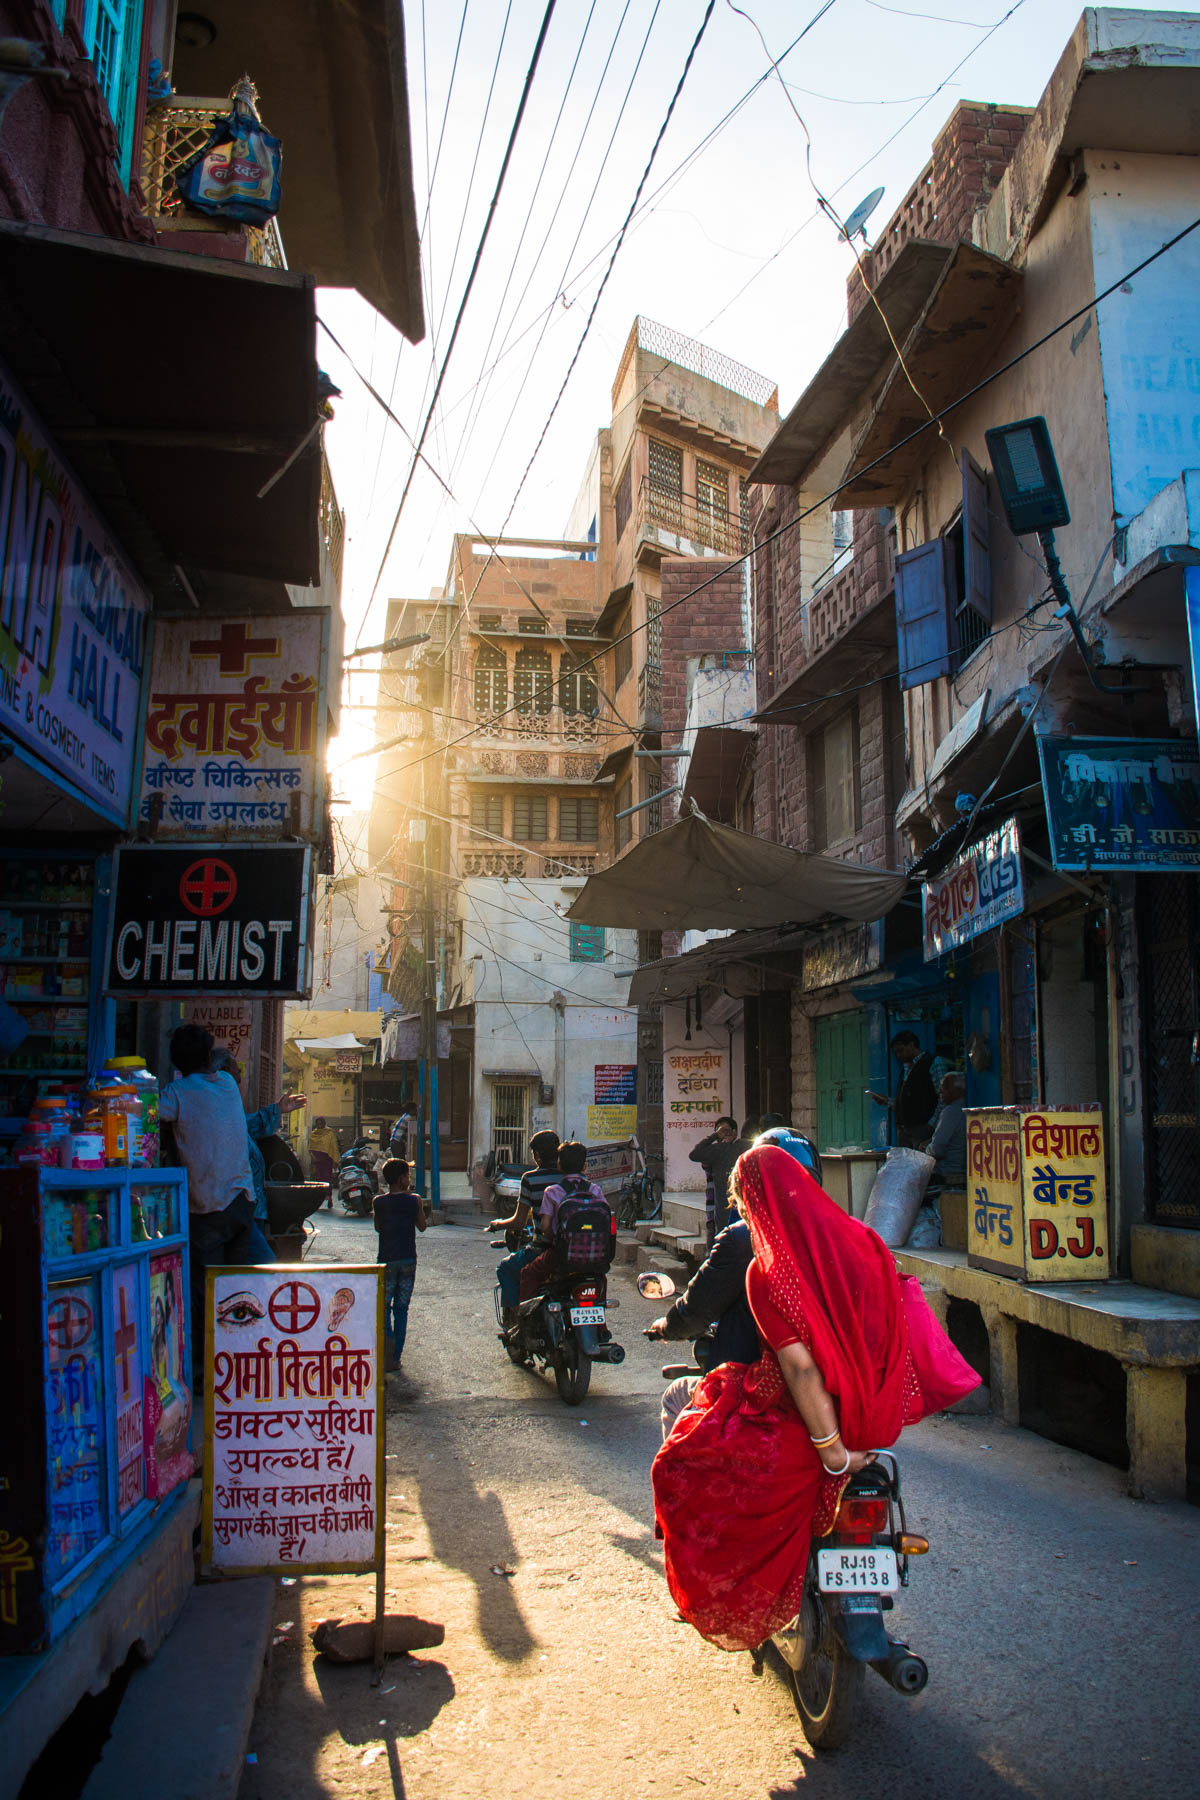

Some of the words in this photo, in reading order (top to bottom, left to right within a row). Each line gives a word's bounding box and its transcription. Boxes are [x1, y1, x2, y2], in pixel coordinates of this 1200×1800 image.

[70, 525, 143, 681] MEDICAL
[68, 621, 123, 743] HALL
[36, 702, 87, 771] COSMETIC
[145, 762, 196, 788] वरिष्ठ
[203, 761, 302, 791] चिकित्सक
[169, 795, 205, 821] सेवा
[208, 801, 288, 824] उपलब्ध
[117, 920, 293, 982] CHEMIST
[191, 1007, 245, 1020] AVLABLE
[669, 1051, 723, 1071] अक्षयदीप
[968, 1120, 1020, 1182] विशाल
[1022, 1115, 1101, 1159] विशाल
[1032, 1165, 1096, 1207] बैन्ड
[975, 1187, 1014, 1247] बैन्ड
[1029, 1217, 1104, 1260] D.J.
[573, 1315, 604, 1324] 8235
[215, 1338, 273, 1404] शर्मा
[214, 1410, 304, 1439] डाक्टर
[304, 1401, 375, 1442] सुविधा
[215, 1477, 260, 1510] आँख
[263, 1487, 279, 1507] व
[281, 1484, 326, 1507] कान
[326, 1484, 339, 1504] व
[339, 1474, 372, 1503] बीपी
[253, 1510, 279, 1537] की
[318, 1506, 340, 1533] की
[340, 1504, 374, 1533] जाती
